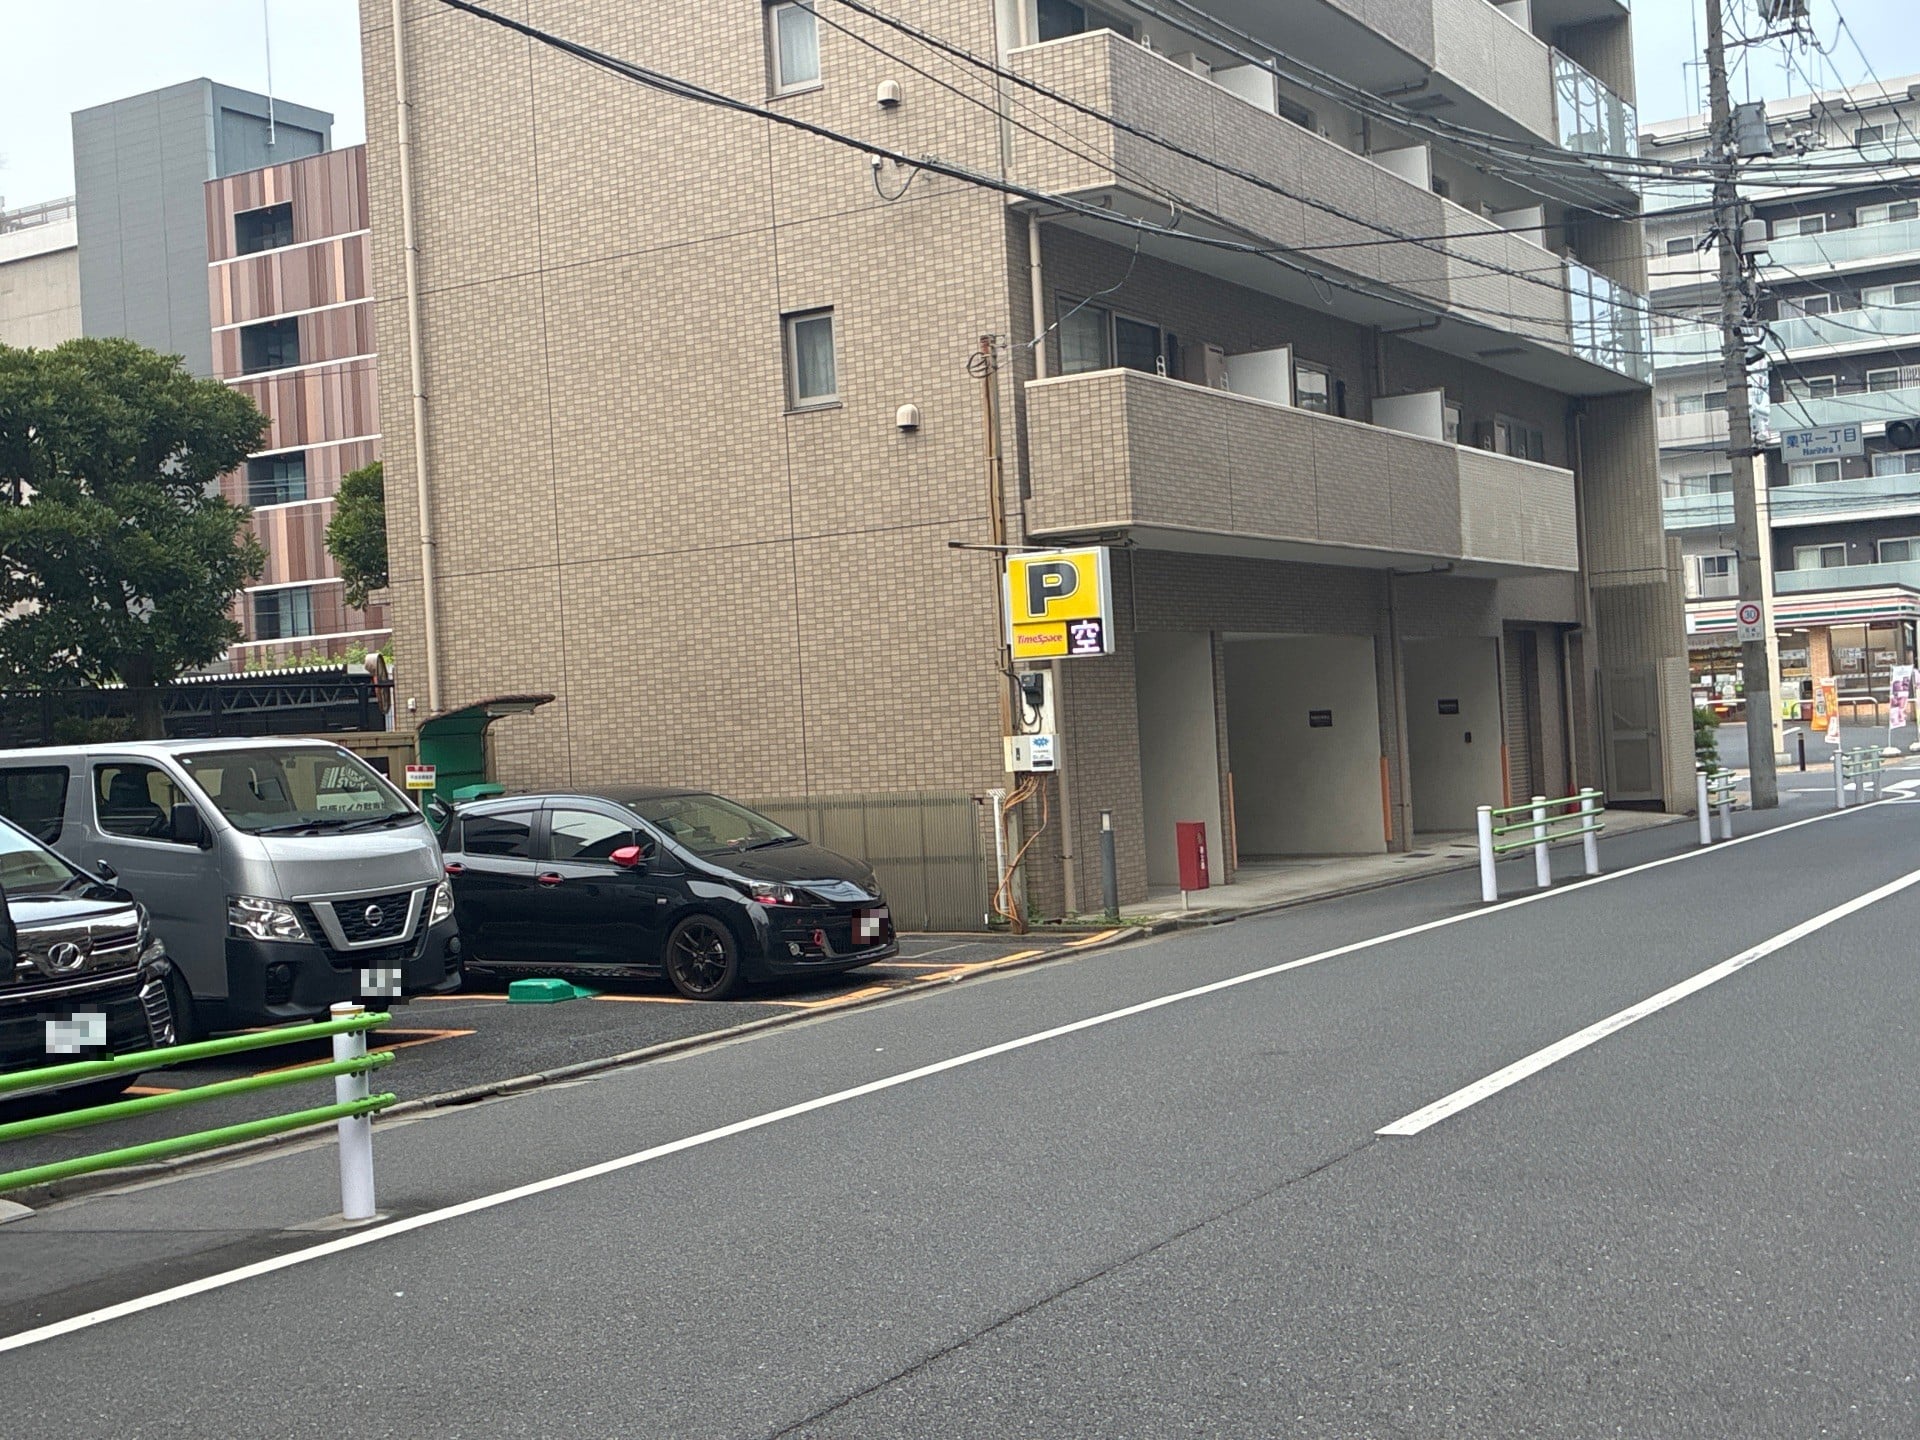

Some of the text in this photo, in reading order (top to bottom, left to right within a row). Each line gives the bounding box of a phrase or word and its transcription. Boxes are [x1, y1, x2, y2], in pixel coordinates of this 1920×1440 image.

[1025, 560, 1080, 617] P
[1744, 610, 1756, 619] 30
[1017, 634, 1063, 645] TimeSpace
[1070, 619, 1100, 654] 空
